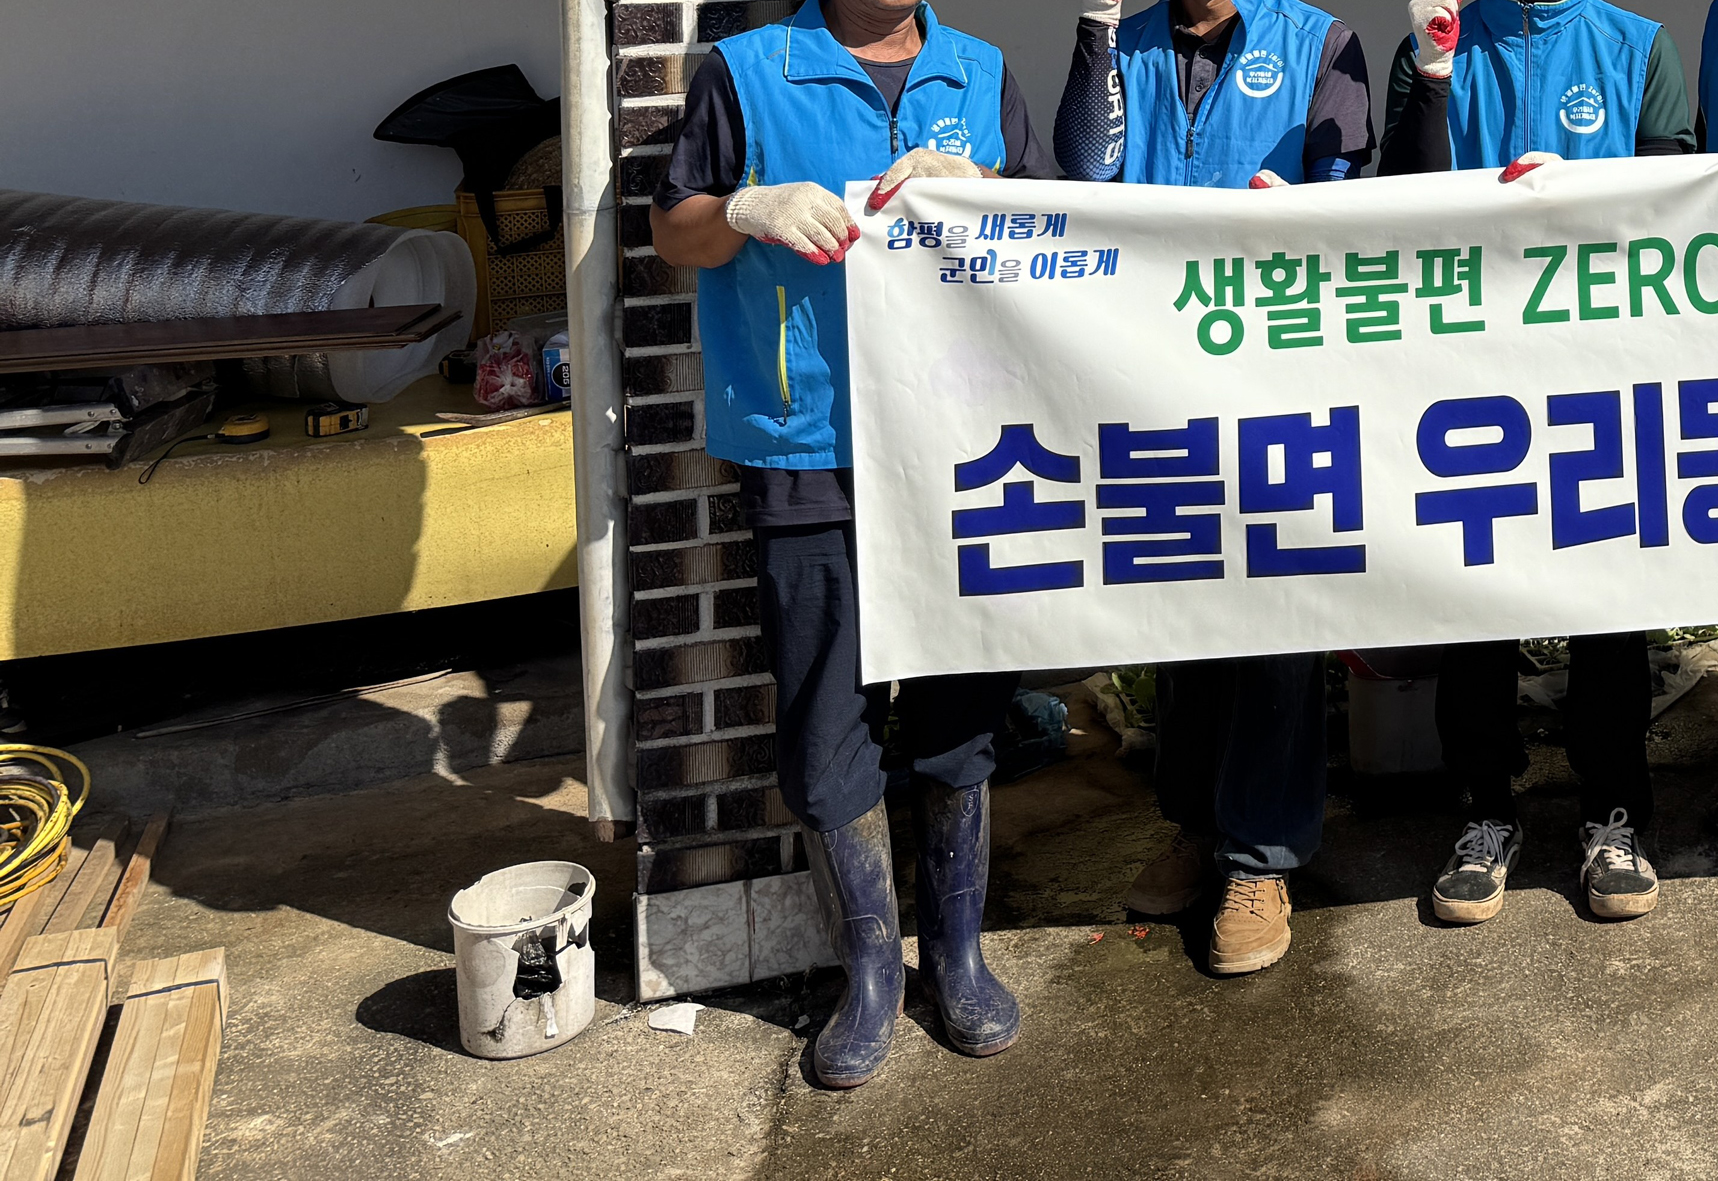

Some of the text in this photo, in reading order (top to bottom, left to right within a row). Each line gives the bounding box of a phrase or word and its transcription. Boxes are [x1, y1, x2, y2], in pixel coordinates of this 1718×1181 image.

[1105, 26, 1125, 165] SPORTS
[886, 212, 1068, 251] 함평을 새롭게
[939, 247, 1120, 284] 군민을 이롭게
[1174, 245, 1485, 355] 생활불편
[951, 404, 1367, 597] 손불면
